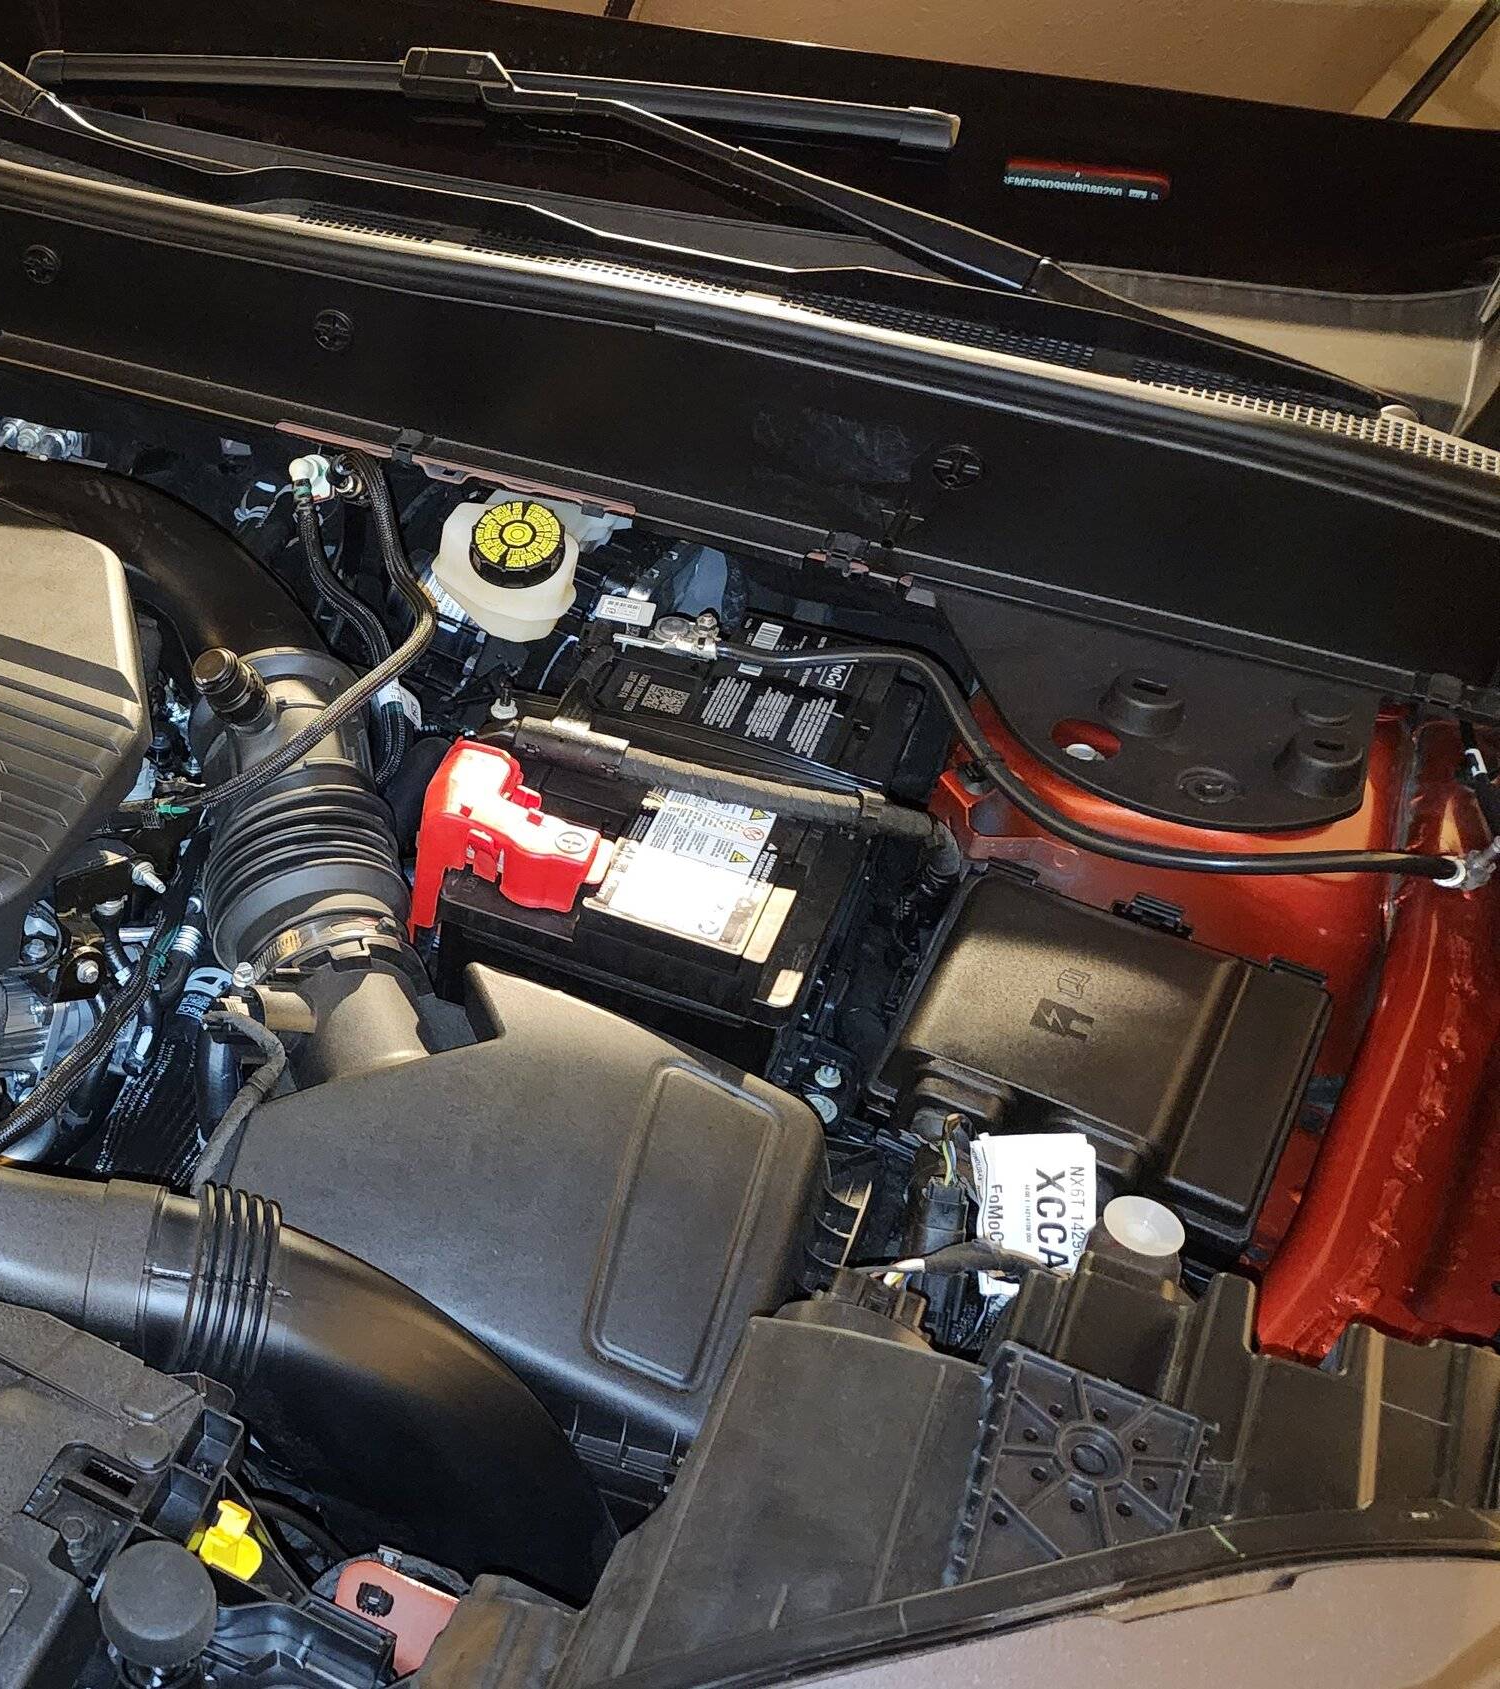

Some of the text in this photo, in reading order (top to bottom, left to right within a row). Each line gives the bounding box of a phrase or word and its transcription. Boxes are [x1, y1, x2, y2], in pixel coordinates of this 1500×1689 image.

[988, 1184, 1004, 1243] FoMoC
[1070, 1166, 1085, 1208] NX6T
[1035, 1167, 1069, 1269] XCCA
